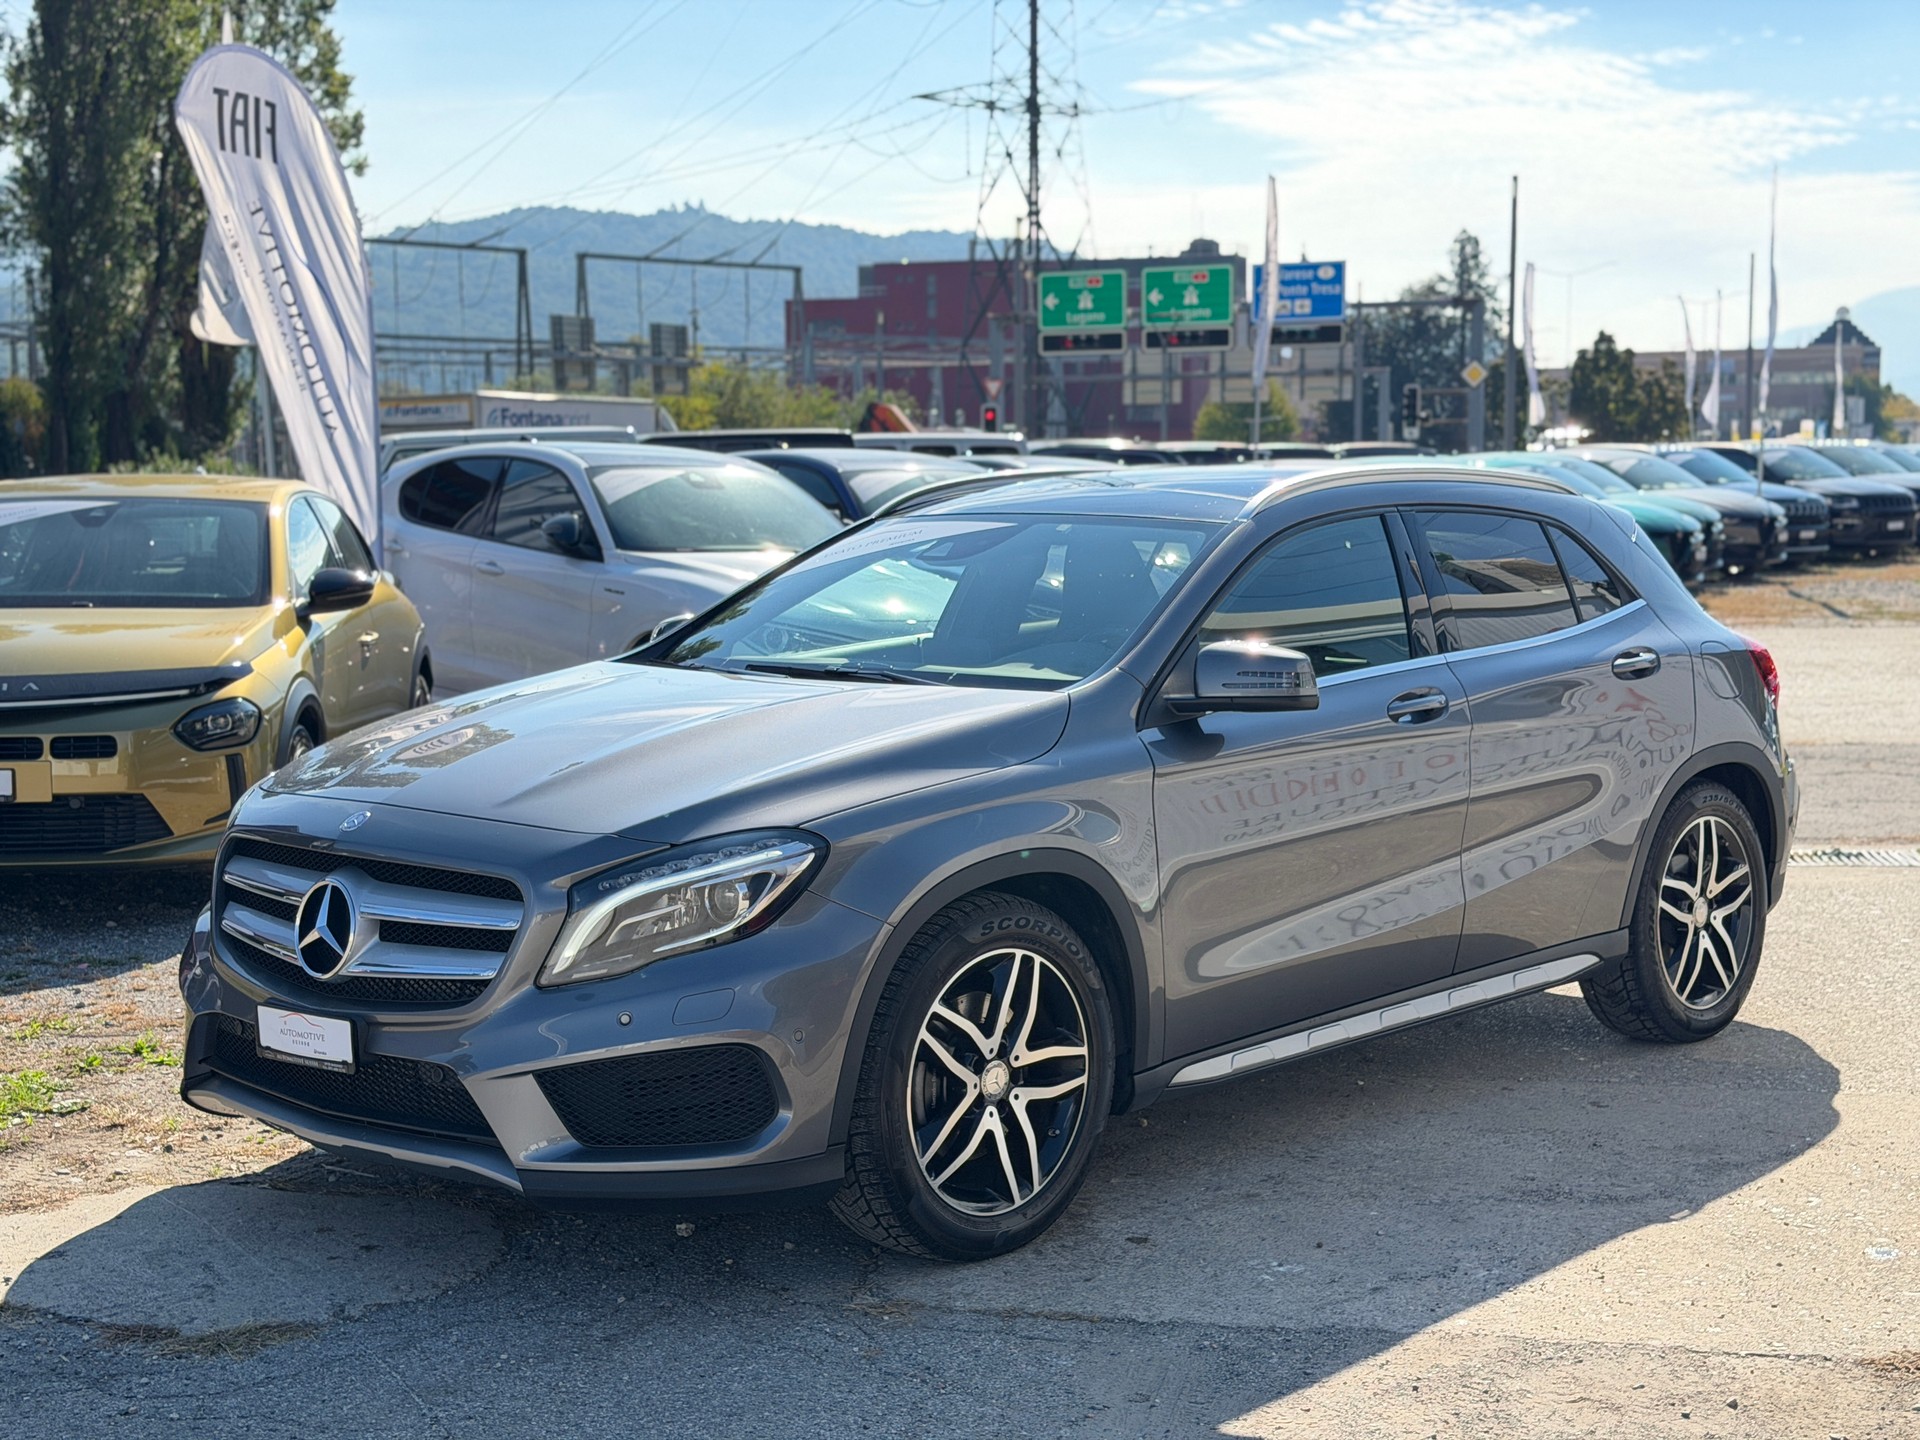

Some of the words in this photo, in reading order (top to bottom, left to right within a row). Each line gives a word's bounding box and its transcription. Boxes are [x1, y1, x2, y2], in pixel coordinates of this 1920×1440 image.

[1310, 282, 1341, 295] Tresa
[1066, 311, 1106, 325] Lugano
[981, 917, 1094, 974] SCORPION
[280, 1028, 325, 1042] AUTOMOTIVE
